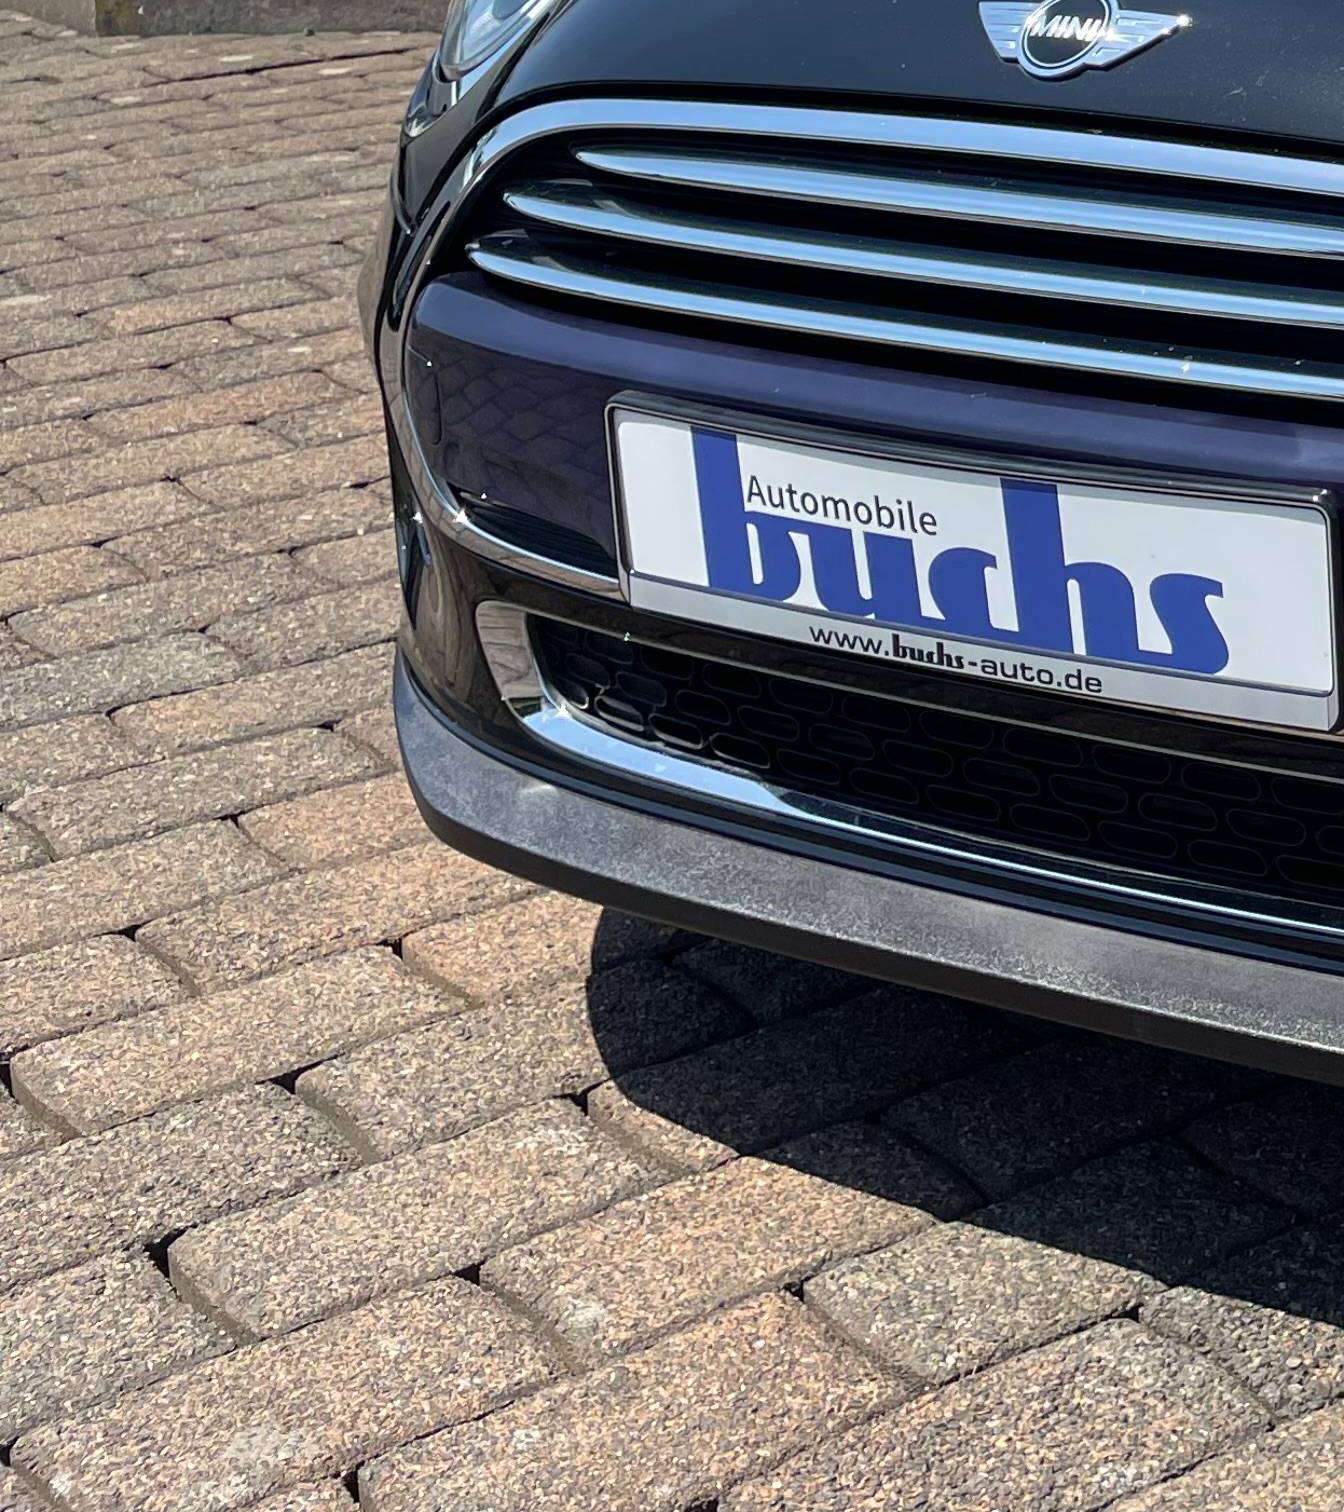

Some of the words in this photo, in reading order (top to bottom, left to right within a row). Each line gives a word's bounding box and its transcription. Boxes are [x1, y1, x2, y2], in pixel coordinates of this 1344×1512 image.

[745, 474, 938, 537] Automobile
[690, 425, 1230, 675] buchs
[809, 626, 1103, 693] www.buchs-auto.de
